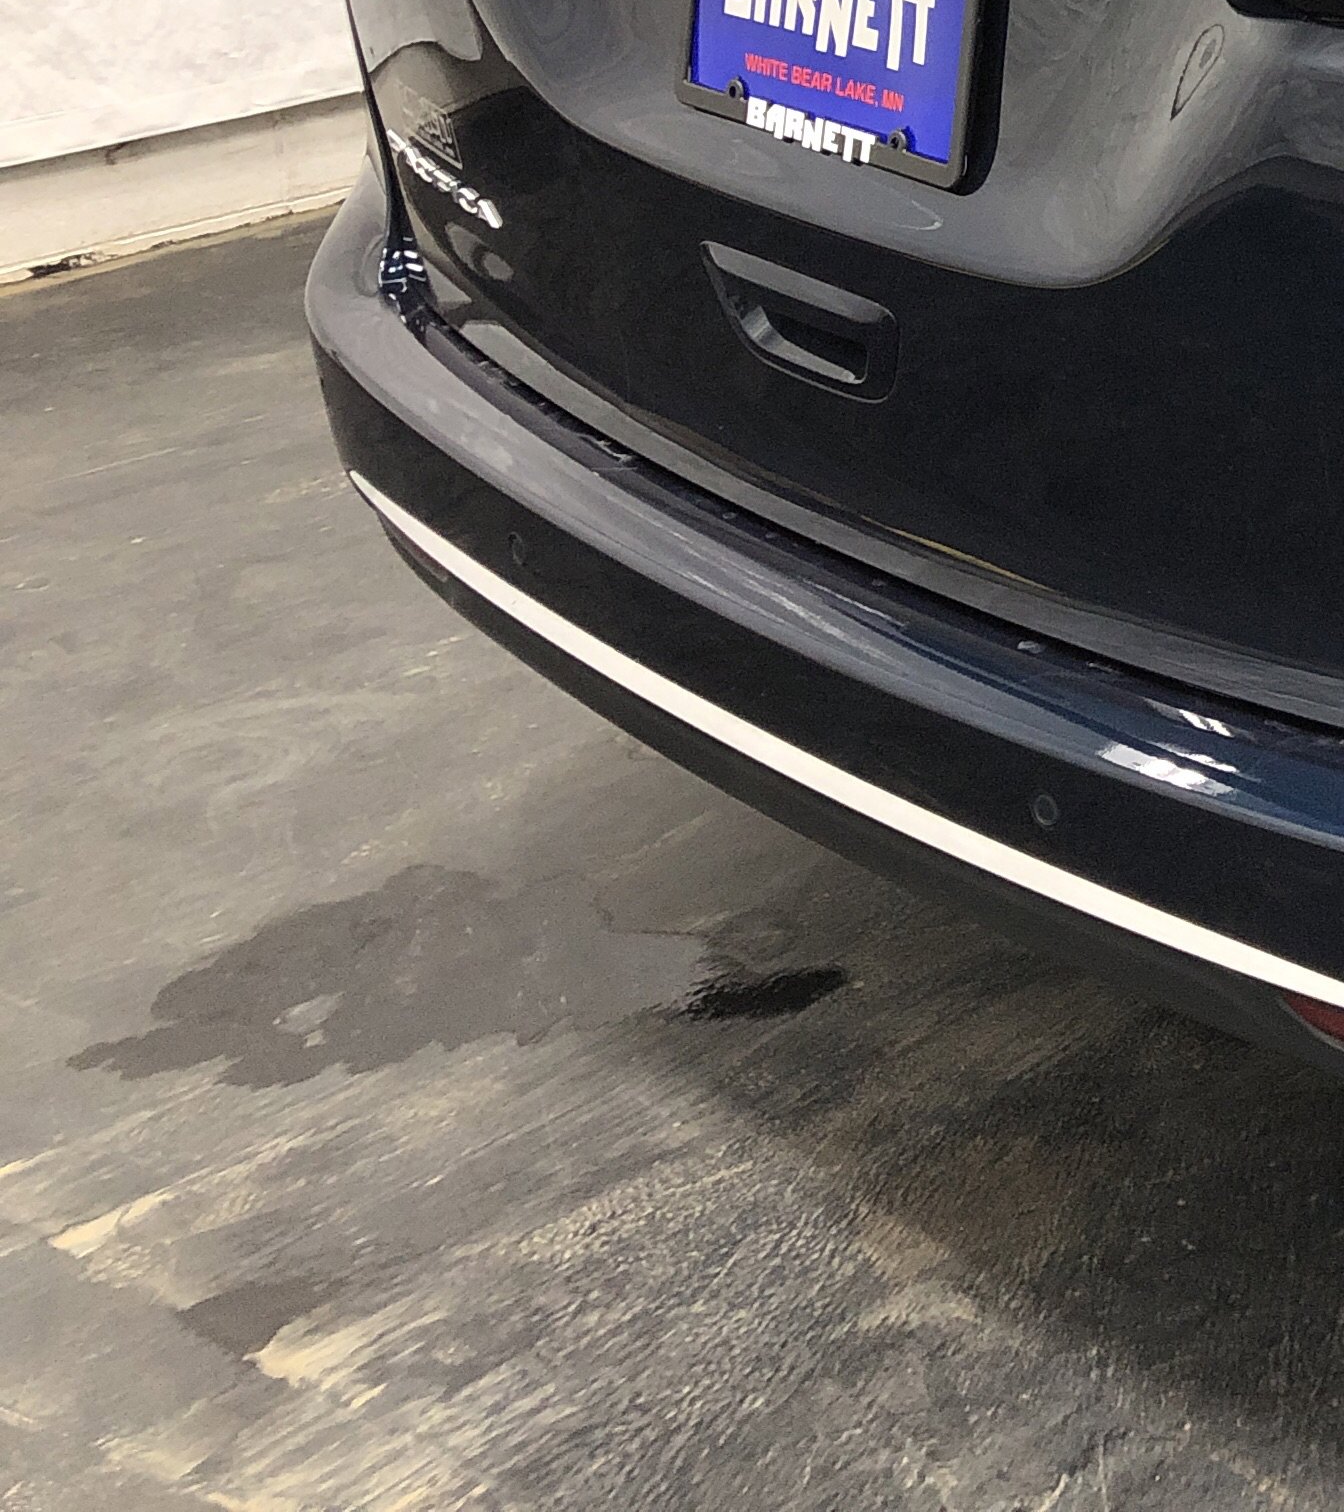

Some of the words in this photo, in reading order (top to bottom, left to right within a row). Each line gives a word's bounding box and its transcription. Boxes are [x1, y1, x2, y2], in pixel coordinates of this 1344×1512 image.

[745, 53, 788, 81] WHITE
[791, 65, 833, 93] BEAR
[835, 74, 878, 108] LAKE,
[882, 89, 905, 113] MN
[746, 96, 876, 164] BARNETT
